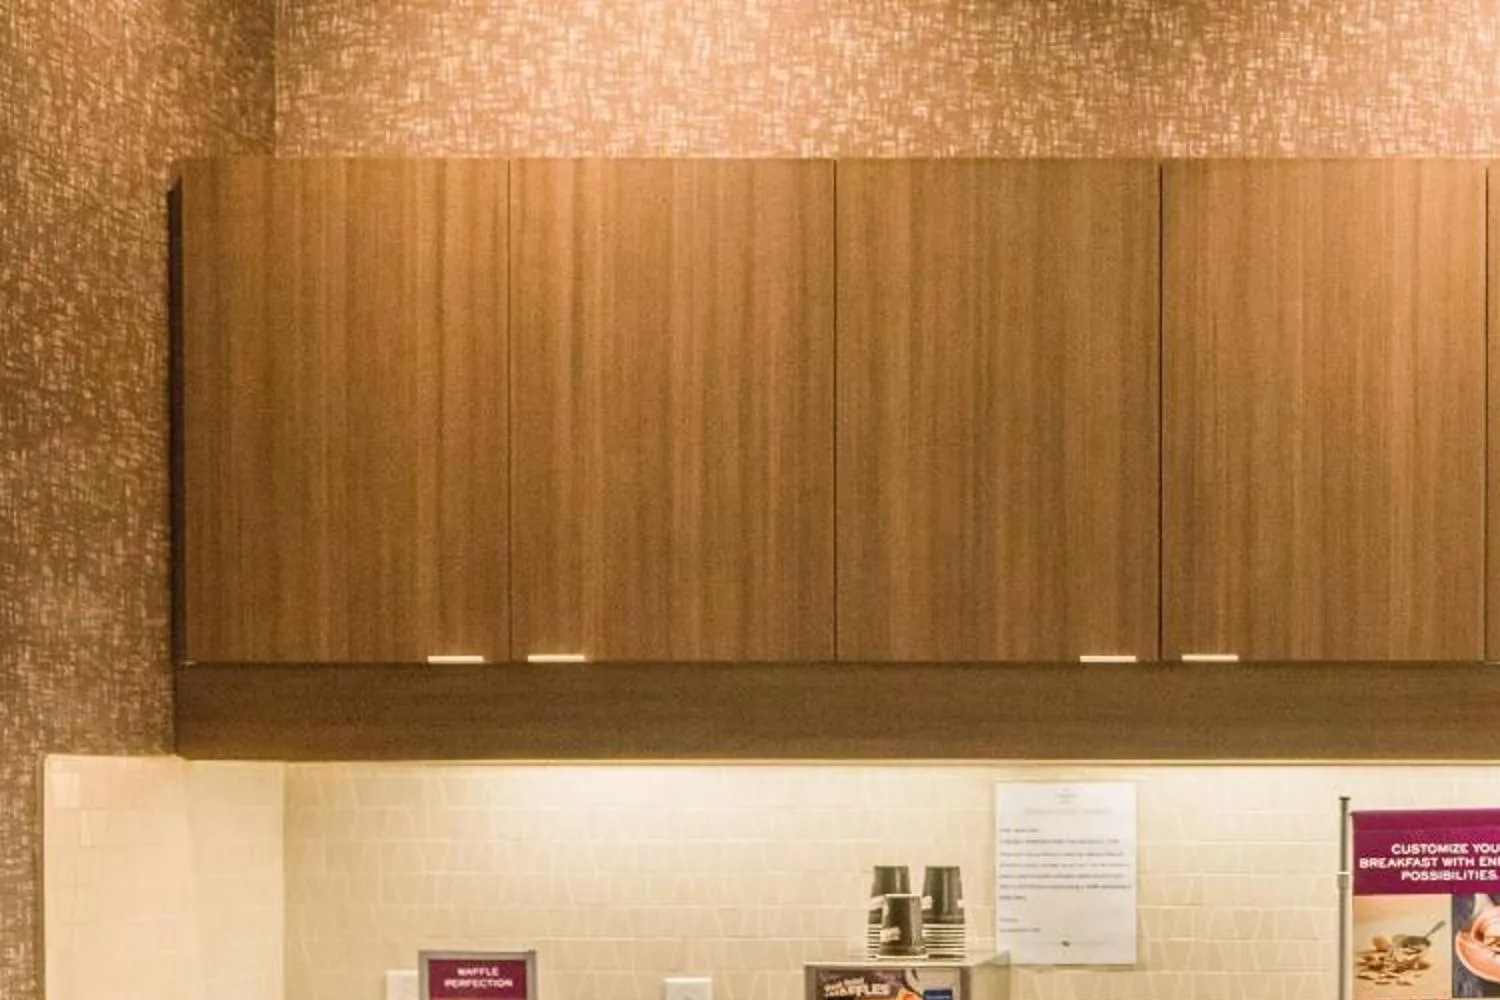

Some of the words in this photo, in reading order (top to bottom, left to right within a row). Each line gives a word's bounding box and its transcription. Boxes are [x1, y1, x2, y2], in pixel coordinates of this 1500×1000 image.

[1391, 843, 1469, 855] CUSTOMIZE
[1359, 857, 1439, 869] BREAKFAST
[1441, 856, 1475, 867] WITH
[1401, 869, 1500, 881] POSSIBILITIES.
[457, 967, 499, 977] WAFFLE
[443, 978, 514, 989] PERFECTION
